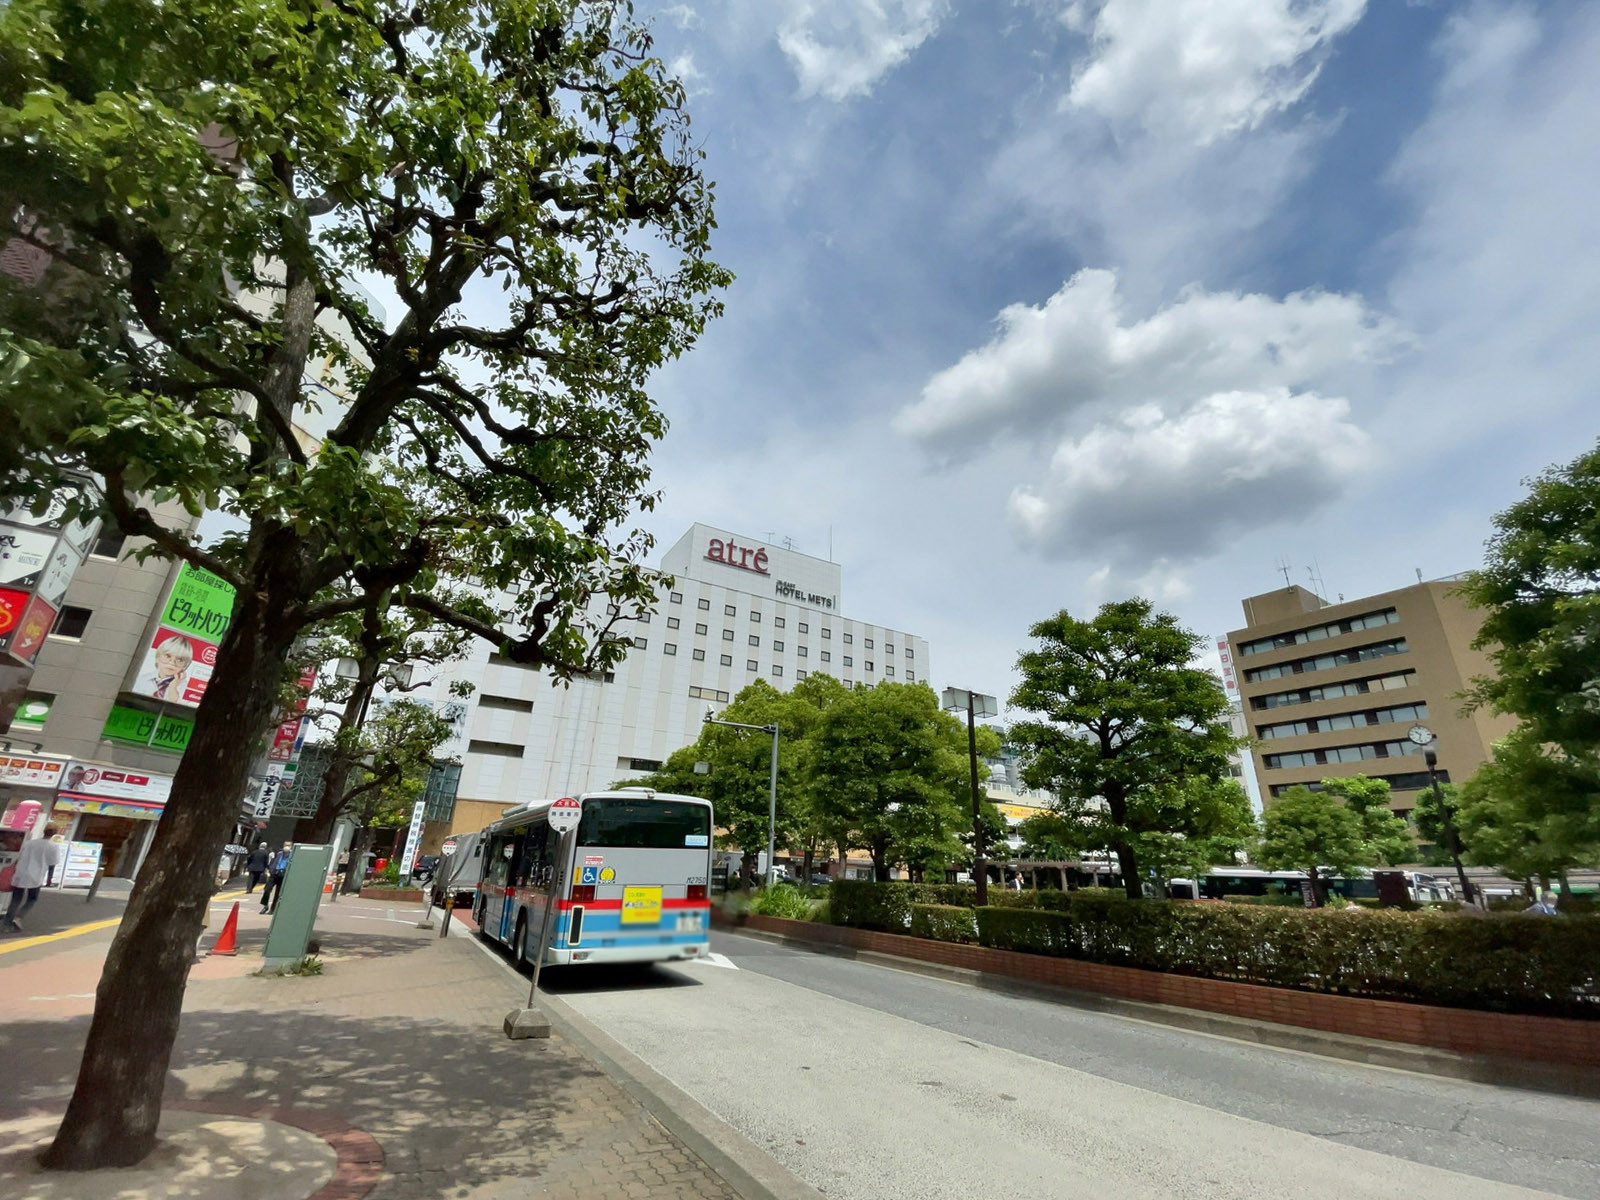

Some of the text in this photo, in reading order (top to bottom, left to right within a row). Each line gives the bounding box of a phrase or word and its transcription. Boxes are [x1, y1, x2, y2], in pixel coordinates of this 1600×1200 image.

[707, 538, 769, 573] atré
[775, 584, 832, 608] HOTEL METS
